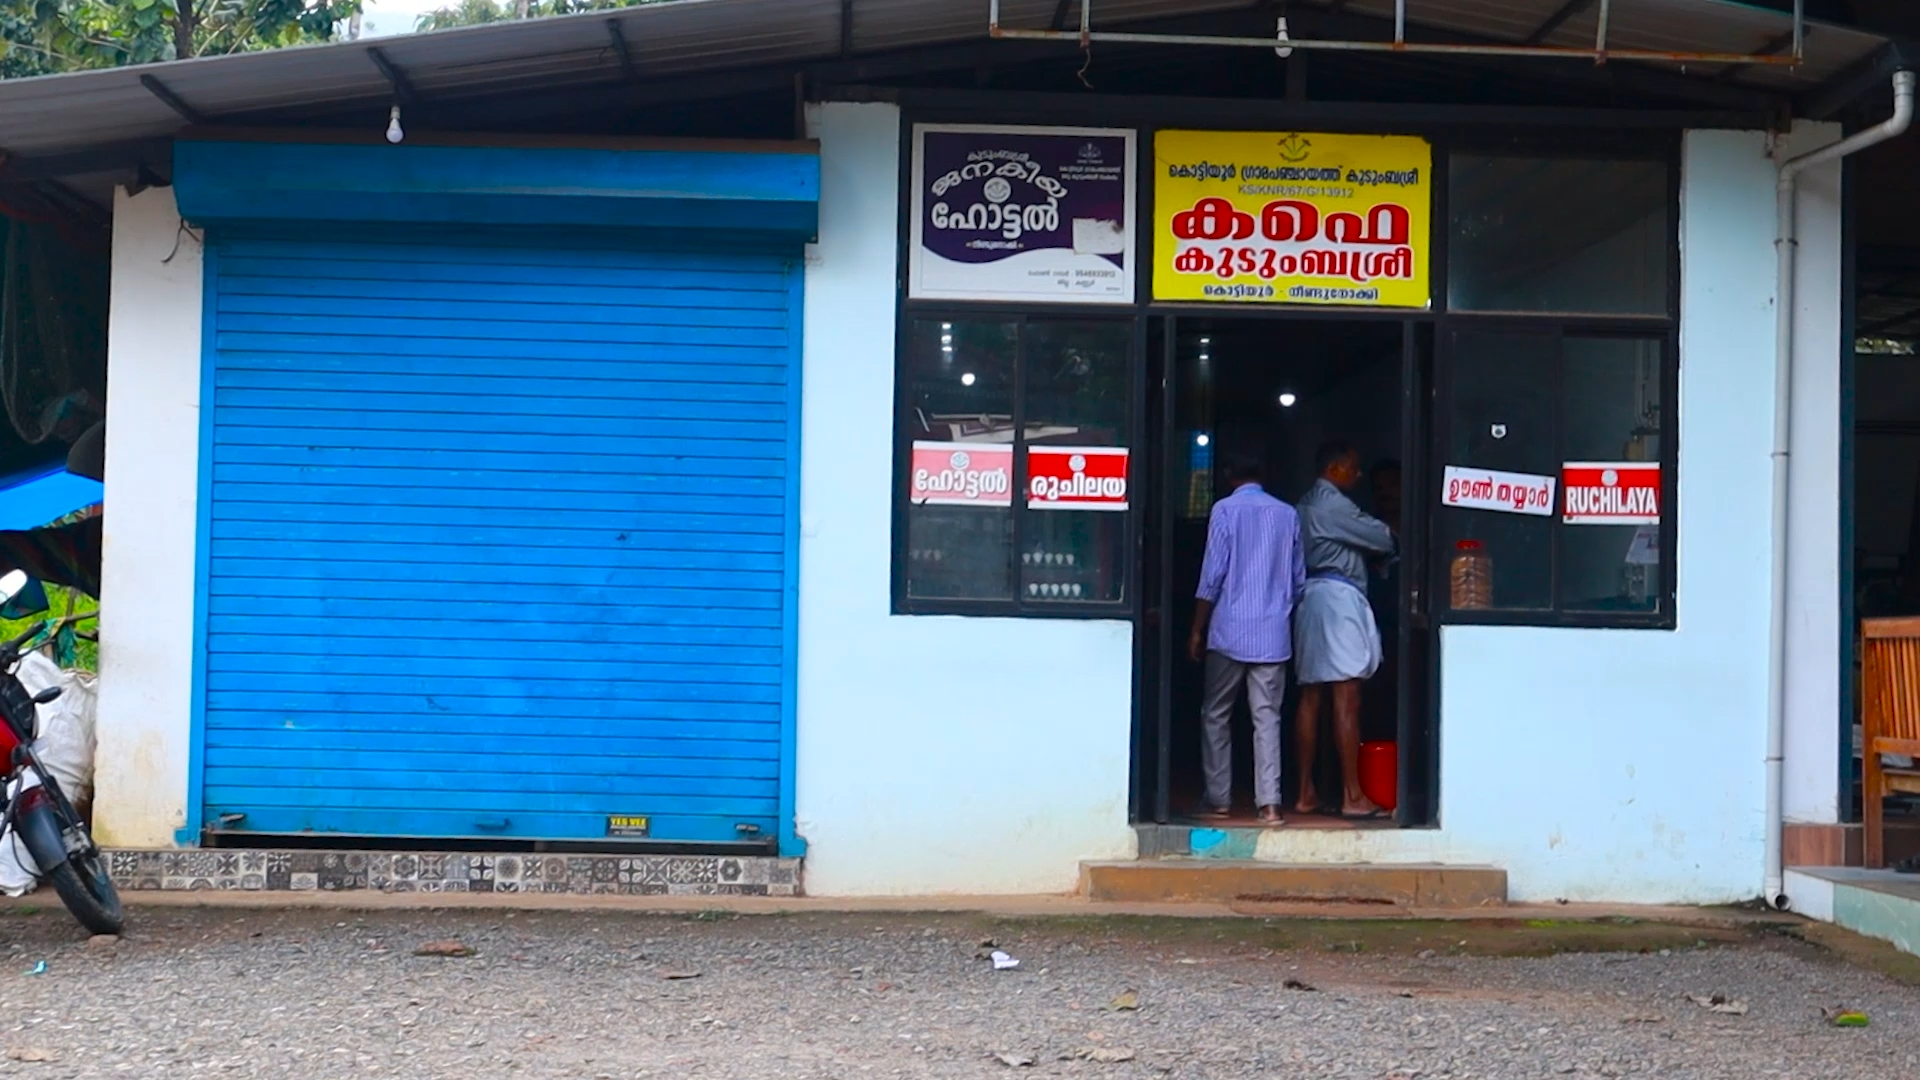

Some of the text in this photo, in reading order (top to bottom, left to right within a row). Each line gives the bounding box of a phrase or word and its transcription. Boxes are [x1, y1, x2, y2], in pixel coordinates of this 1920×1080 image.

[931, 161, 1068, 198] ജനകീയ
[1169, 161, 1419, 188] കൊട്ടിയൂർ ഗ്രാമപഞ്ചായത്ത് കുടുംബശ്രീ
[931, 196, 1059, 239] ഹോട്ടൽ
[1172, 197, 1410, 245] കഫെ
[1174, 246, 1414, 282] കുടുംബശ്രീ
[1204, 283, 1274, 299] കൊട്ടിയൂർ
[914, 467, 1008, 498] ഹോട്ടൽ
[1031, 472, 1126, 500] രുചിലയ
[1496, 481, 1549, 510] തയ്യാർ
[1566, 486, 1658, 514] RUCHILAYA
